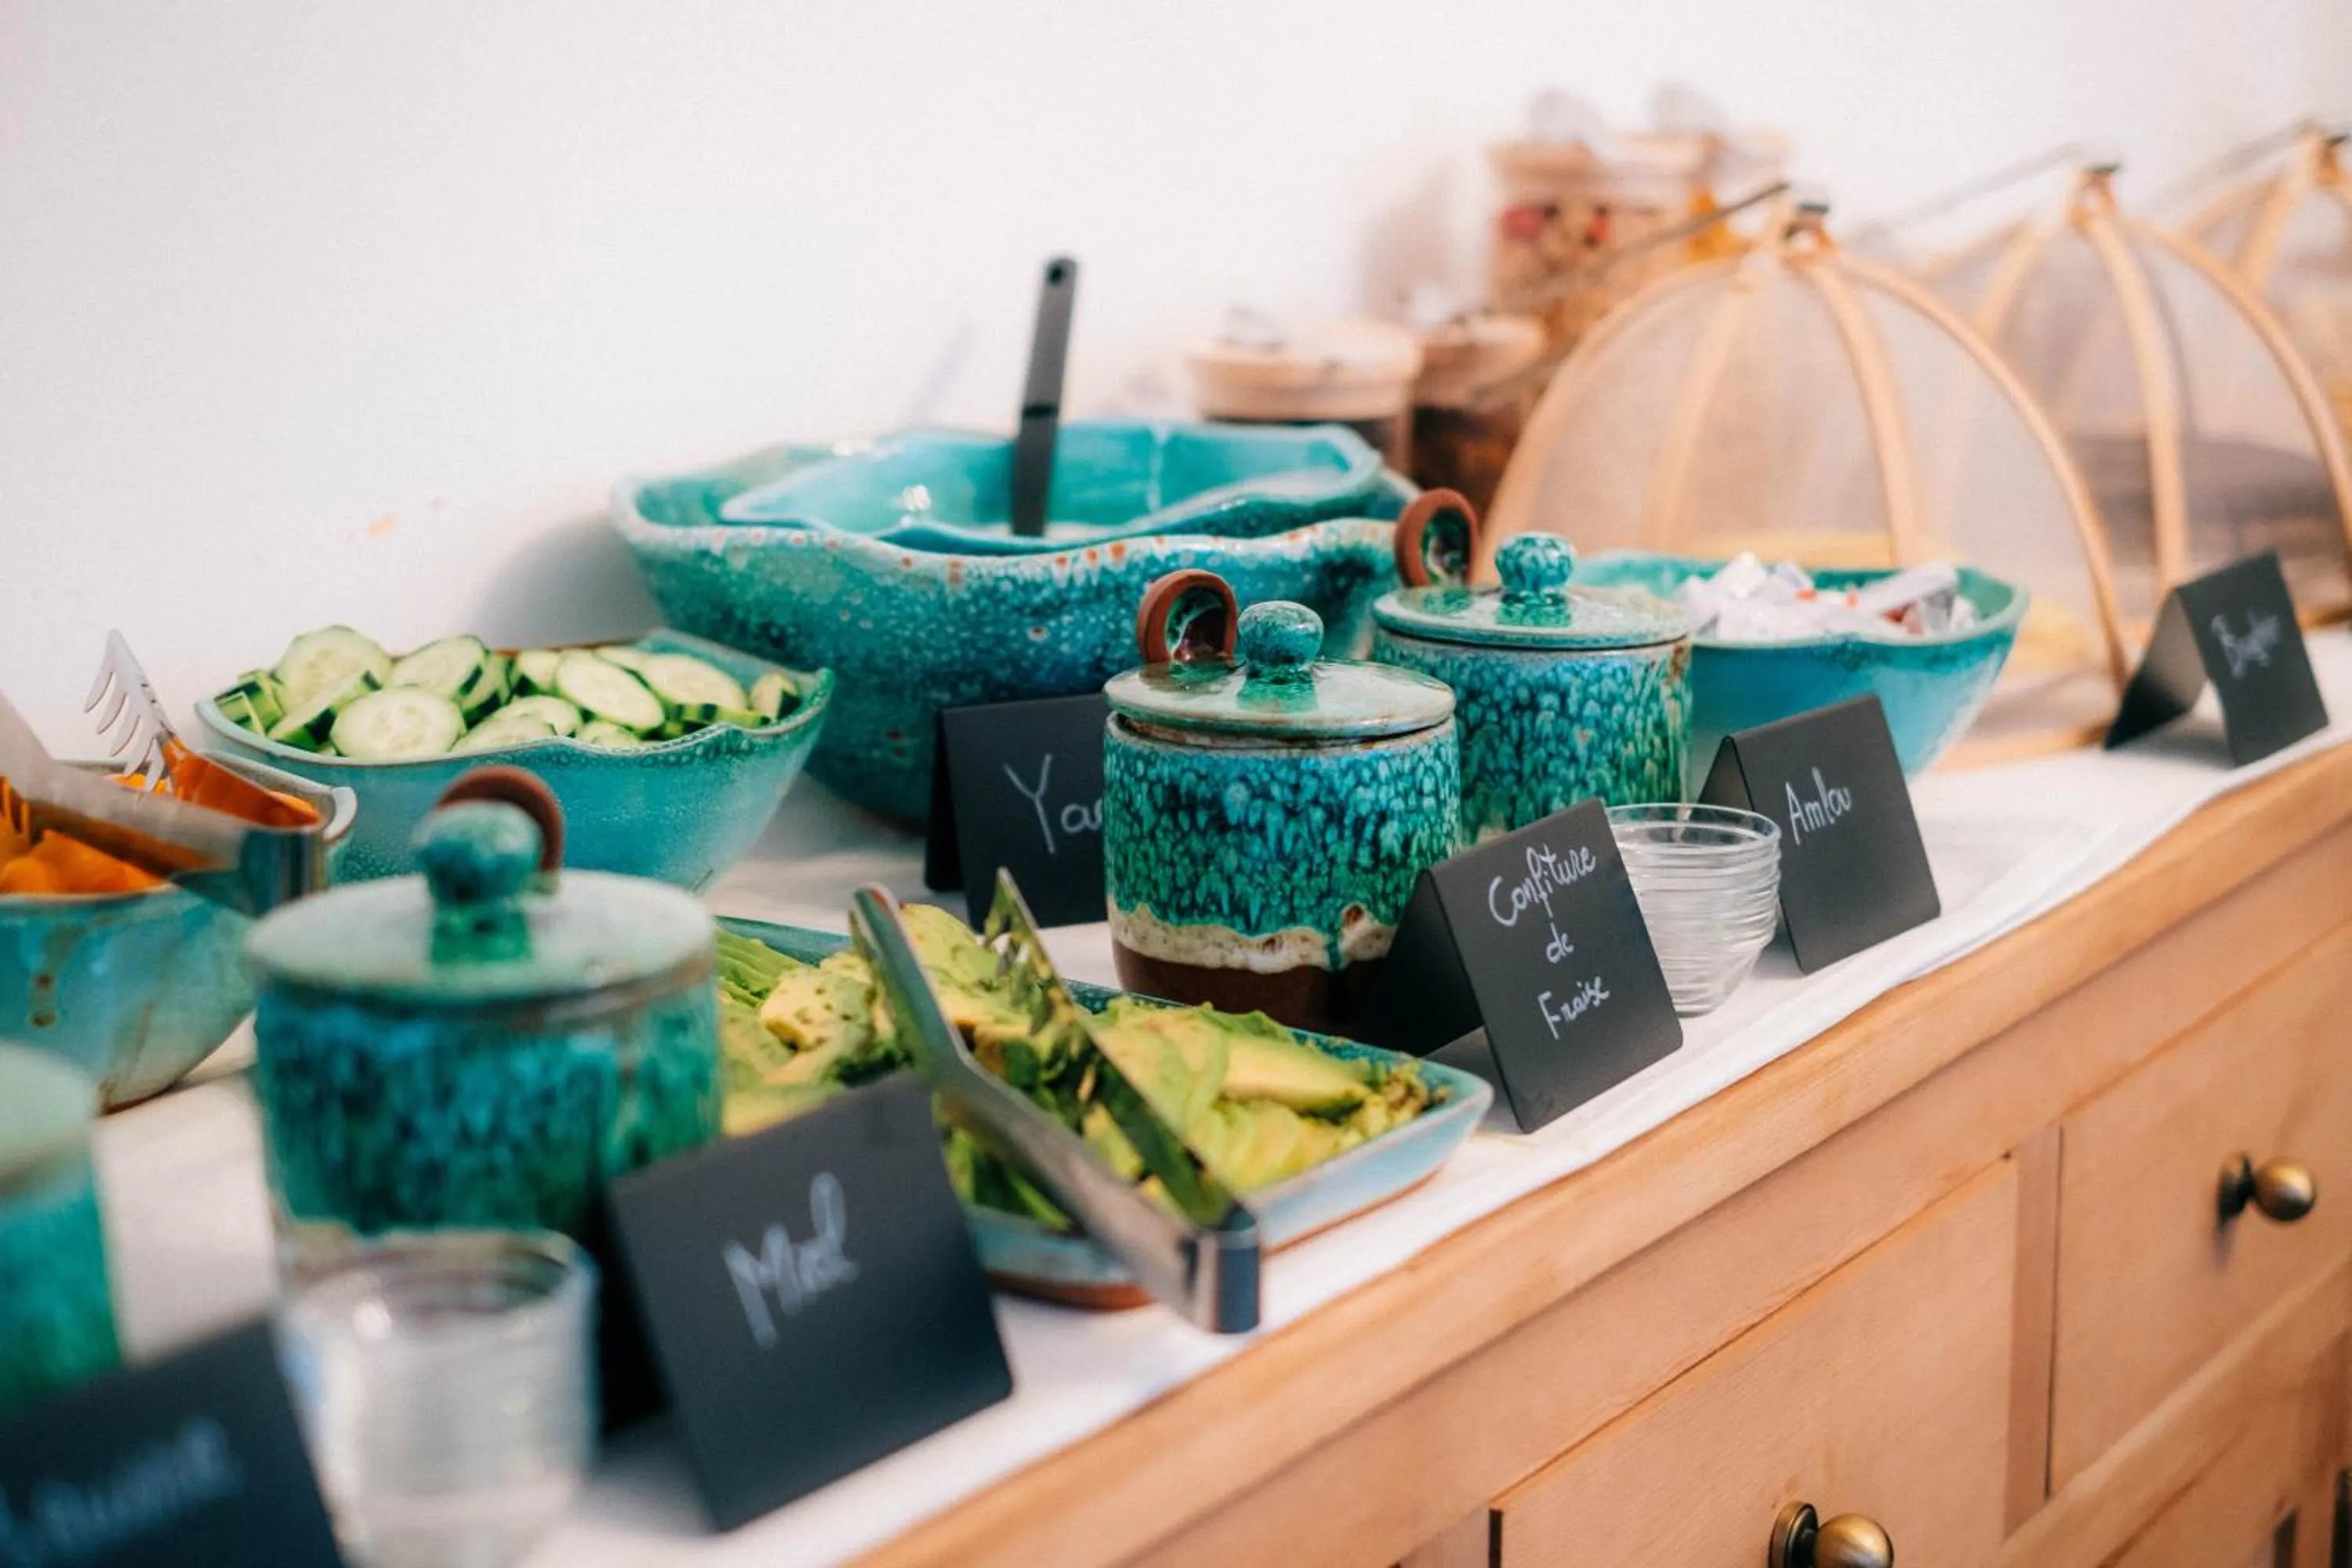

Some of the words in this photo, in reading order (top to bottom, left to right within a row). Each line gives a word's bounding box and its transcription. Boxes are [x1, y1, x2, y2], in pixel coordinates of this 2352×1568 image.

[1003, 753, 1103, 854] Ya
[1784, 765, 1853, 847] Amlou
[1489, 843, 1596, 927] Confiture
[1545, 921, 1574, 964] de
[1537, 975, 1610, 1040] Fraise
